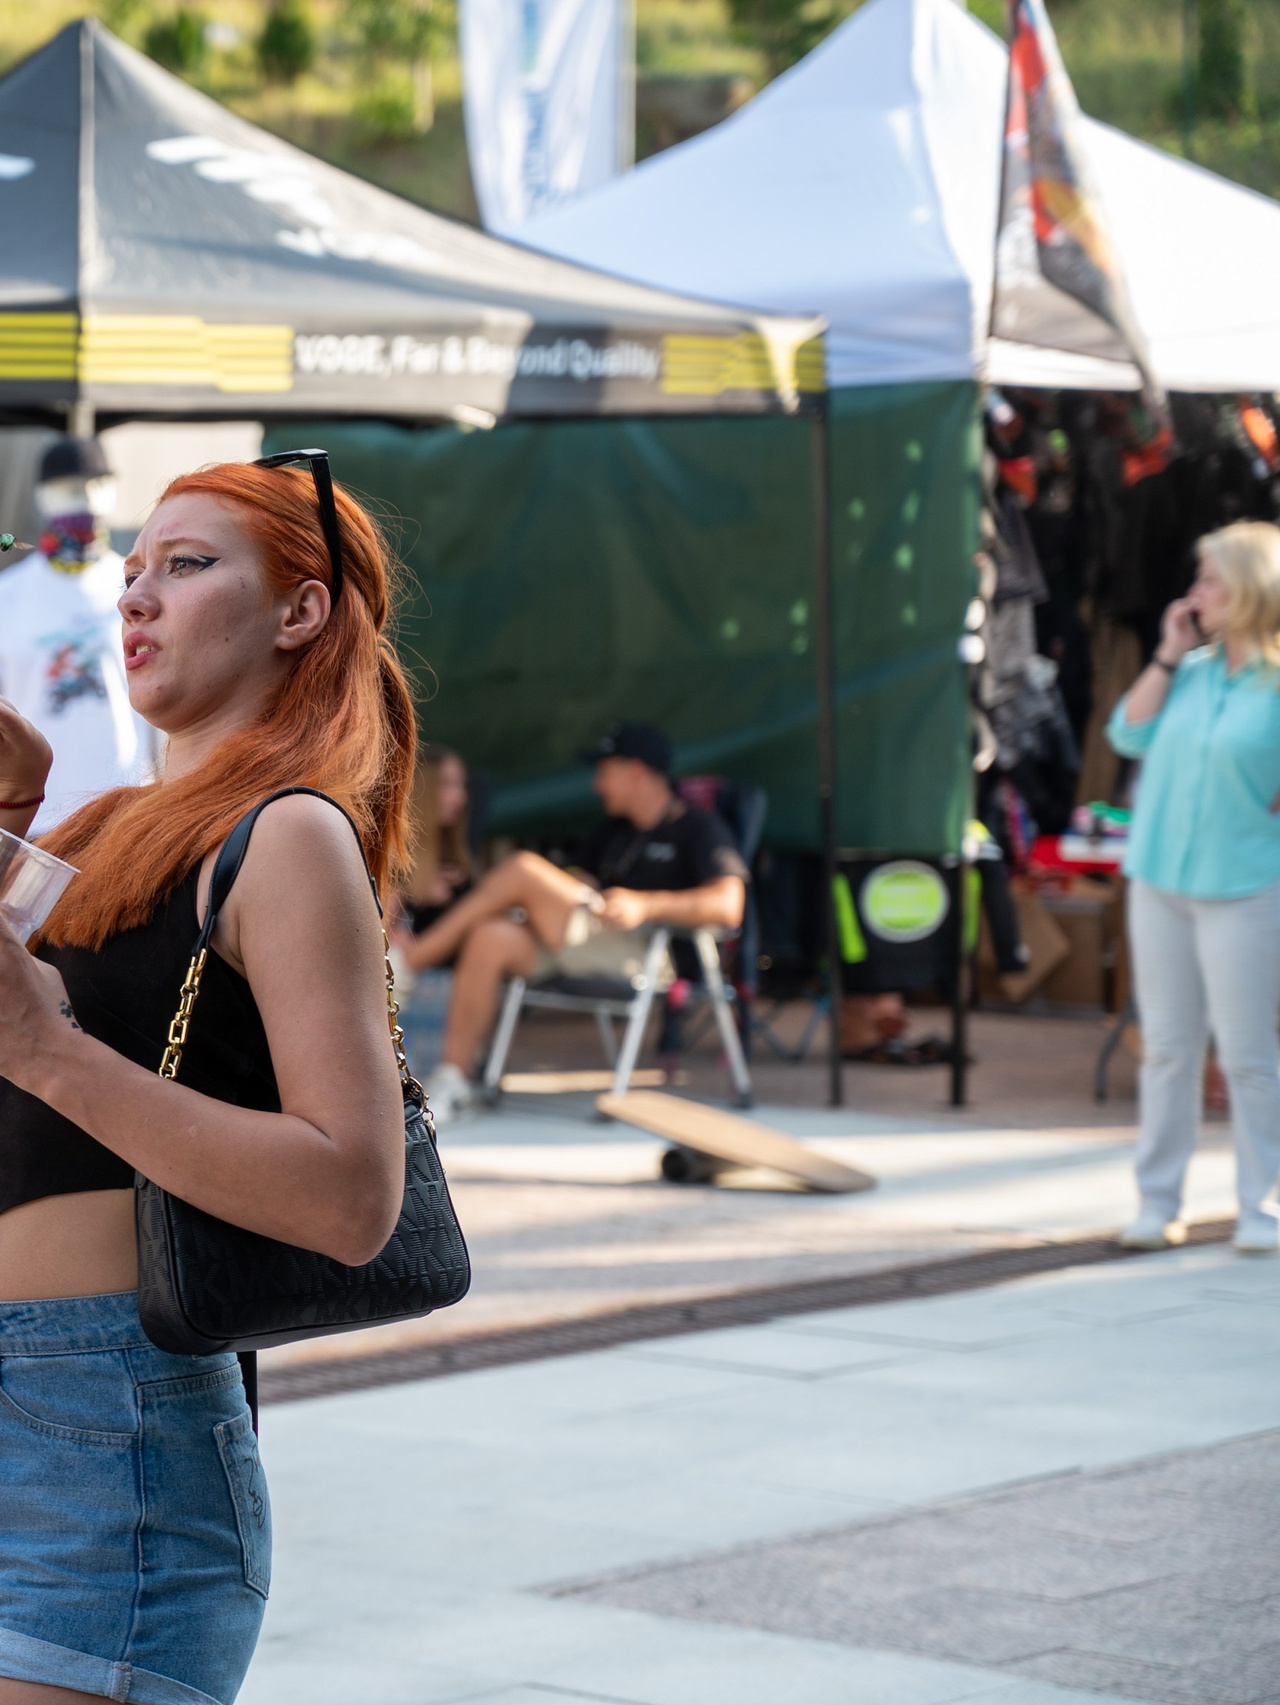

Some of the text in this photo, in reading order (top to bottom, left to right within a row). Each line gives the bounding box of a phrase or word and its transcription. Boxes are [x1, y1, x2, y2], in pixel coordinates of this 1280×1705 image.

[295, 334, 661, 384] VOGE, Far & Beyond Quality
